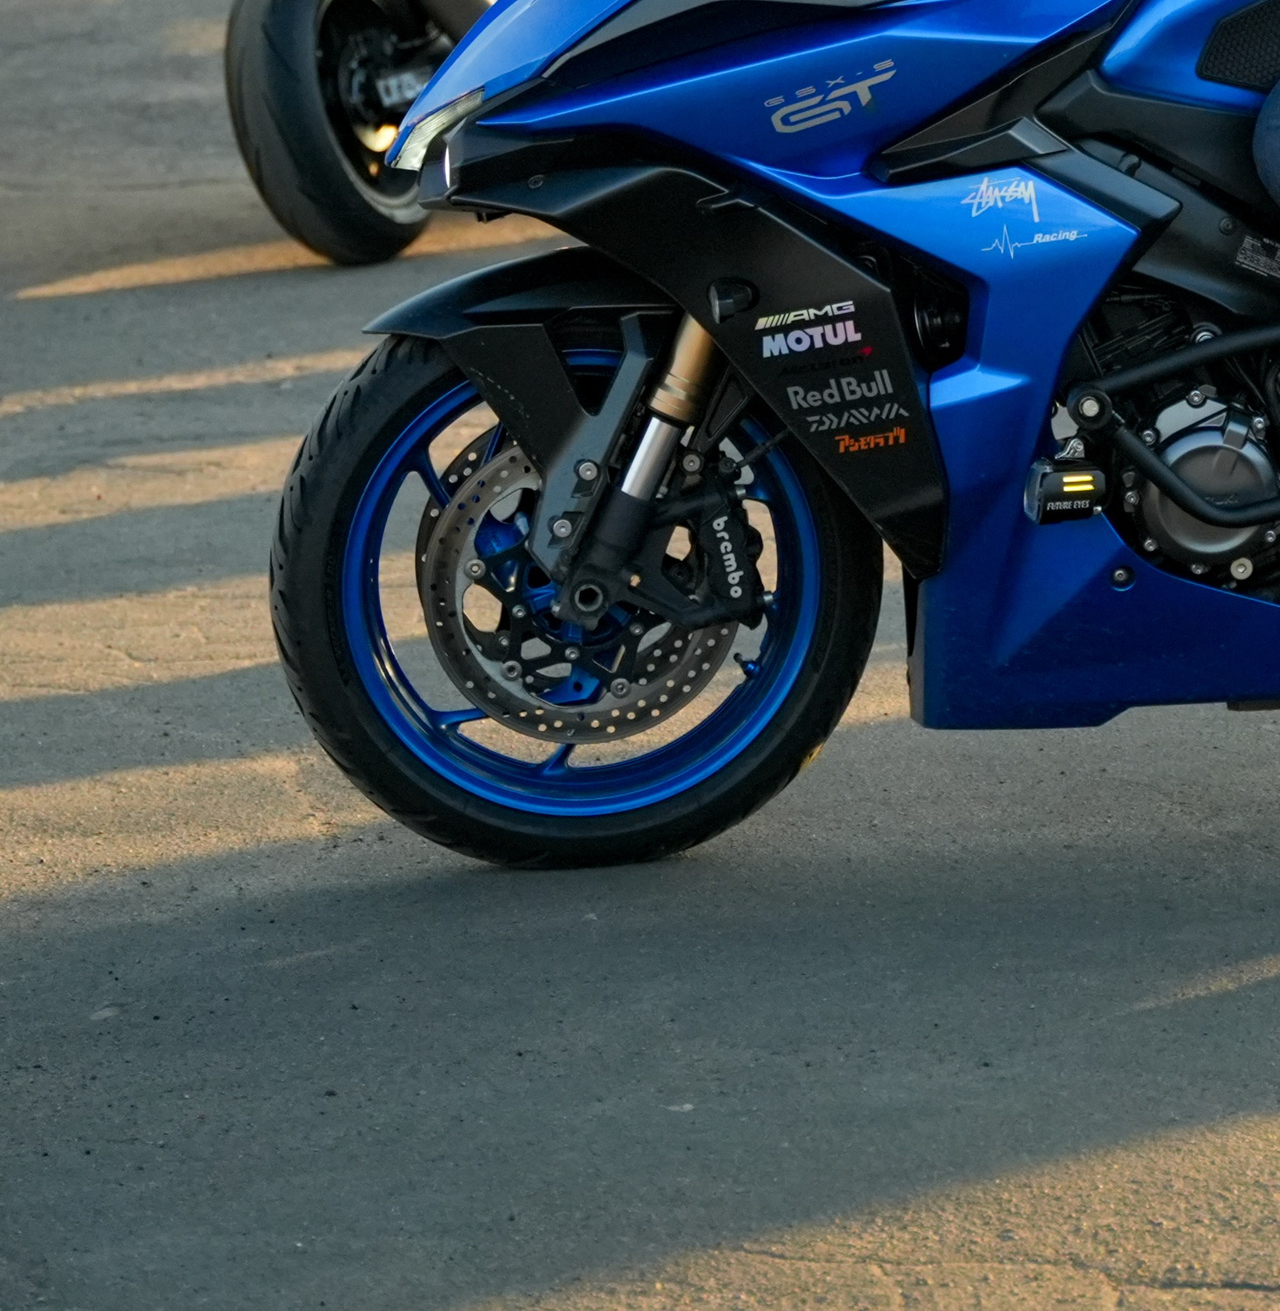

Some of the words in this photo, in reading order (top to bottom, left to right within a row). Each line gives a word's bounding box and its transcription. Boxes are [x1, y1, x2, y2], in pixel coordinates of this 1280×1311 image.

[770, 69, 897, 133] GT
[1033, 229, 1079, 244] Racing
[762, 320, 863, 359] MOTUL
[786, 378, 842, 411] Red
[840, 369, 894, 402] Bull
[1046, 501, 1073, 511] FUTURE
[1073, 499, 1091, 509] EYES
[712, 515, 744, 598] brembo
